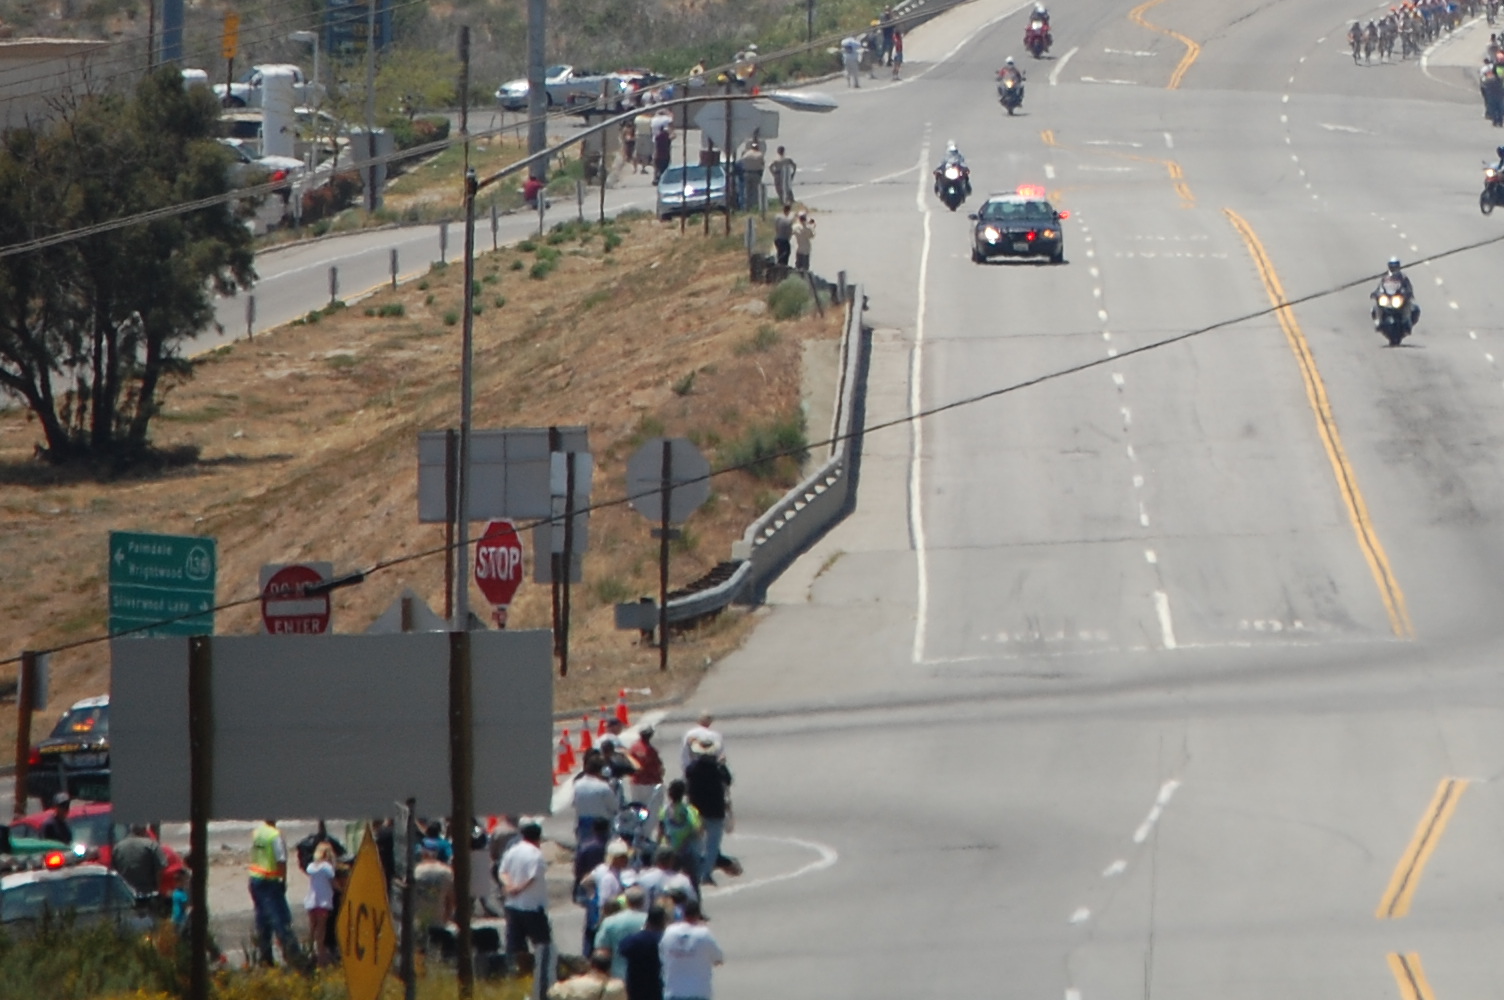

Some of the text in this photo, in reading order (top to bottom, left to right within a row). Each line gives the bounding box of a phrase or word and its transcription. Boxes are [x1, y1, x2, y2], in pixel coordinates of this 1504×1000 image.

[127, 541, 172, 556] Palmdale
[128, 561, 183, 580] Wrightwood
[476, 545, 521, 581] STOP
[274, 619, 321, 635] ENTER
[345, 900, 386, 966] ICY
